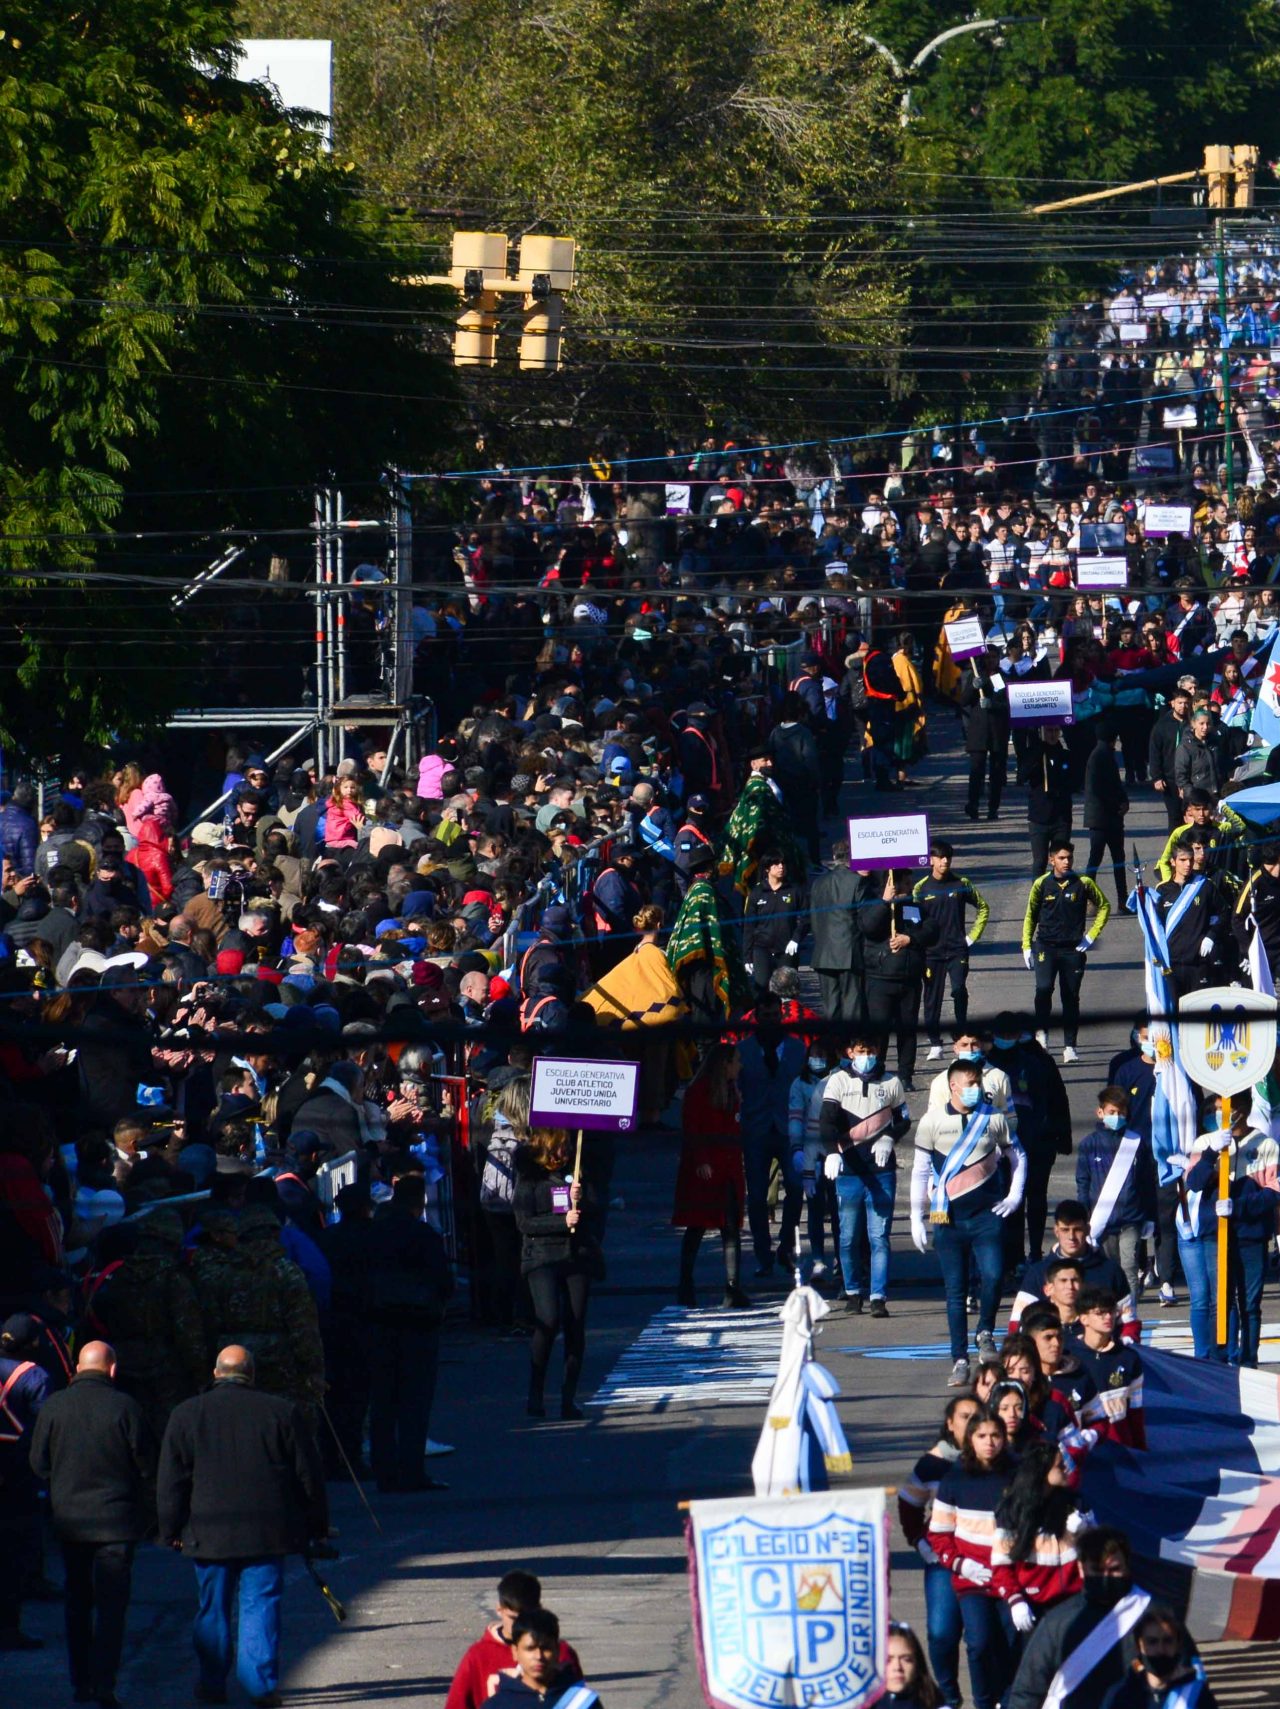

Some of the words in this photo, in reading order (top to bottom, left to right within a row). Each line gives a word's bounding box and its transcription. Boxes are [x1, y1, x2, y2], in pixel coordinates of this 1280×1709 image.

[857, 831, 884, 839] ESCUELA
[884, 828, 919, 837] GENERATIVA
[881, 837, 898, 845] GEPU
[545, 1068, 579, 1078] ESCUELA
[580, 1070, 625, 1080] GENERATIVA
[556, 1078, 576, 1087] CLUB
[577, 1079, 614, 1089] ATLETICO
[550, 1087, 592, 1097] JUVENTUD
[593, 1089, 617, 1098] UNIDA
[554, 1097, 612, 1108] UNIVERSITARIO
[751, 1566, 782, 1610] C
[805, 1619, 835, 1664] P
[733, 1664, 784, 1704] DEL
